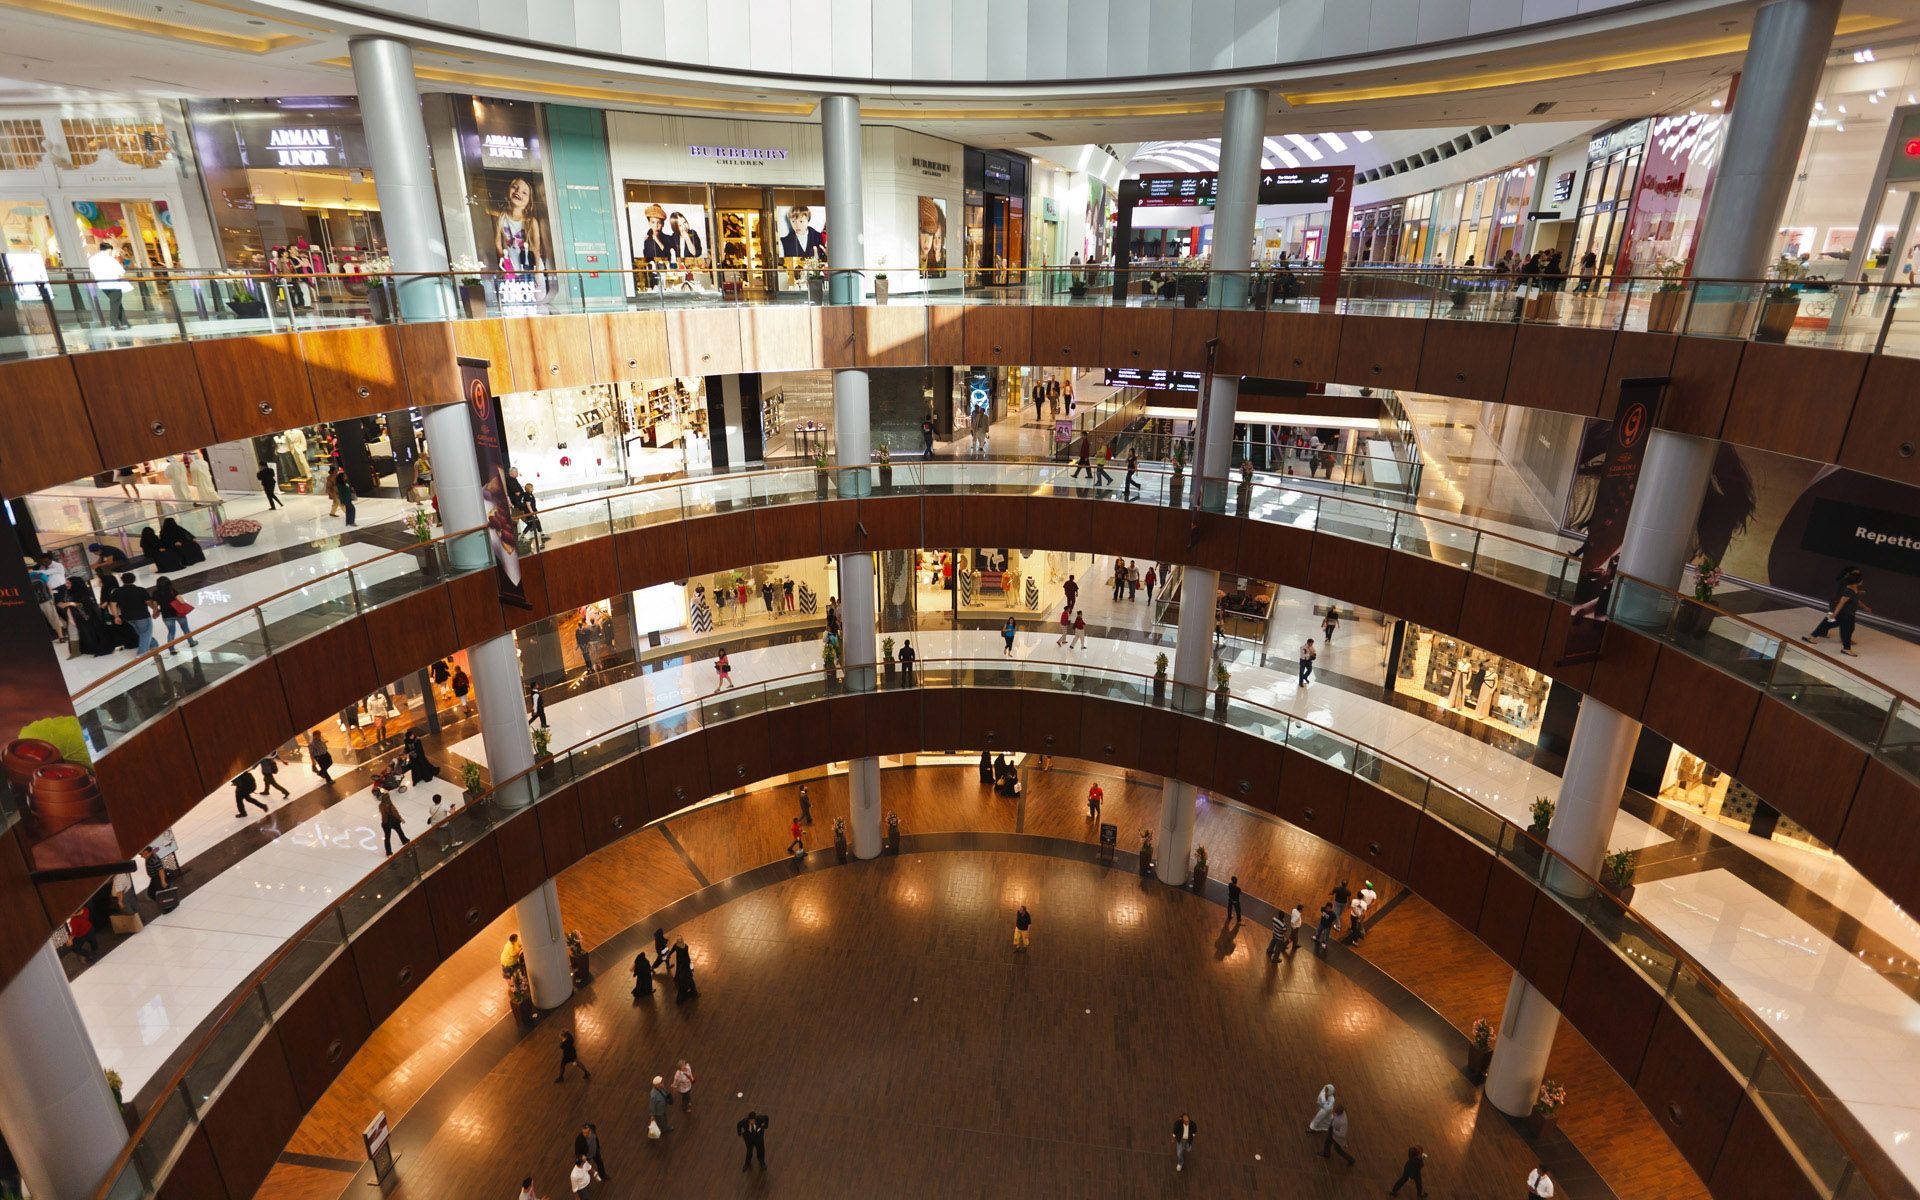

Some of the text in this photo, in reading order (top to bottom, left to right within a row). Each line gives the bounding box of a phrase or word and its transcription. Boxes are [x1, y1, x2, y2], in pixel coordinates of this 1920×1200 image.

[270, 128, 330, 146] ARMANI
[485, 134, 525, 147] ARMANI
[278, 149, 330, 166] JUNIOR
[688, 144, 788, 160] BURBERRY
[716, 159, 764, 167] CHILDREN
[912, 157, 952, 173] BURBERRY
[1335, 177, 1346, 193] 2
[1855, 526, 1920, 550] Repetto
